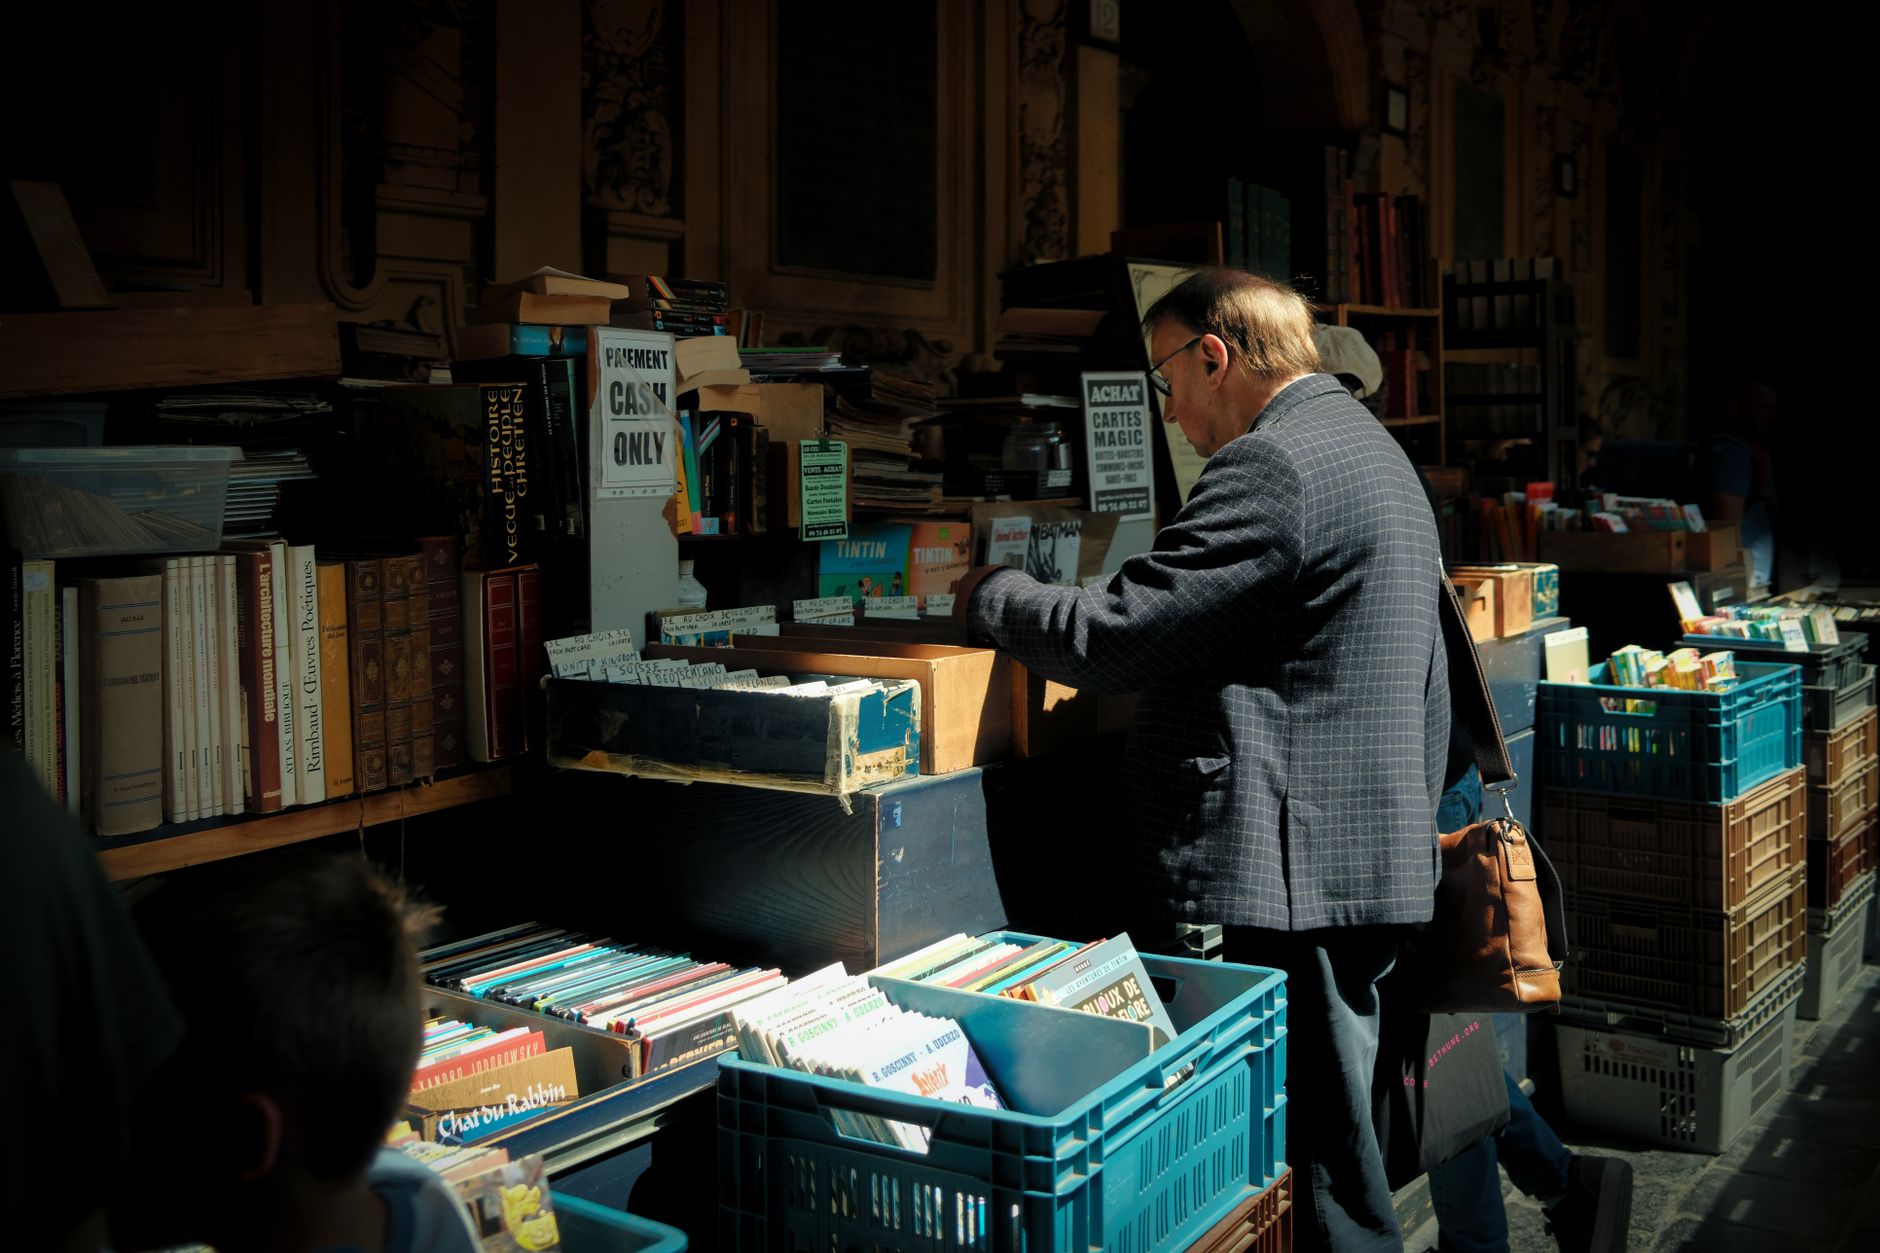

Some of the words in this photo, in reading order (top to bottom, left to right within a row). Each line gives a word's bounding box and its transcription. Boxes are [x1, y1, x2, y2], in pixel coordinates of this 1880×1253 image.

[606, 347, 668, 370] PAIEMENT
[610, 380, 667, 416] CASH
[1091, 384, 1141, 404] ACHAT
[500, 388, 516, 476] PEUPLE
[1092, 411, 1142, 428] CARTES
[488, 390, 504, 494] HISTOIRE
[512, 388, 528, 498] CHRETIEN
[614, 432, 666, 466] ONLY
[1094, 430, 1143, 448] MAGIC
[504, 490, 519, 564] VECUE
[1040, 520, 1082, 540] BATMAN
[836, 541, 887, 558] TINTIN
[913, 547, 953, 564] TINTIN
[260, 563, 272, 658] L'architecture
[300, 560, 316, 631] Poétiques
[695, 614, 715, 622] CHOIX
[10, 620, 22, 669] Florence
[587, 632, 613, 643] CHOIX
[304, 636, 317, 694] Œuvres
[562, 658, 596, 672] UNITED
[601, 652, 637, 666] KINGDOM
[263, 659, 276, 722] mondiale
[304, 704, 320, 773] Rimbaud
[286, 739, 294, 775] ATLAS
[1066, 986, 1075, 994] LES
[1076, 971, 1103, 989] AVENTURES
[1104, 964, 1111, 973] DE
[1112, 955, 1128, 969] TINTIN
[1123, 978, 1141, 998] DE
[797, 1017, 838, 1043] GOSCINNY
[853, 997, 885, 1018] UDERZO
[471, 1041, 539, 1074] JODOROWSKY
[881, 1052, 918, 1078] GOSCINNY
[934, 1029, 961, 1050] UDERZO
[438, 1107, 480, 1138] Chat
[482, 1105, 504, 1124] du
[505, 1082, 566, 1116] Rabbin
